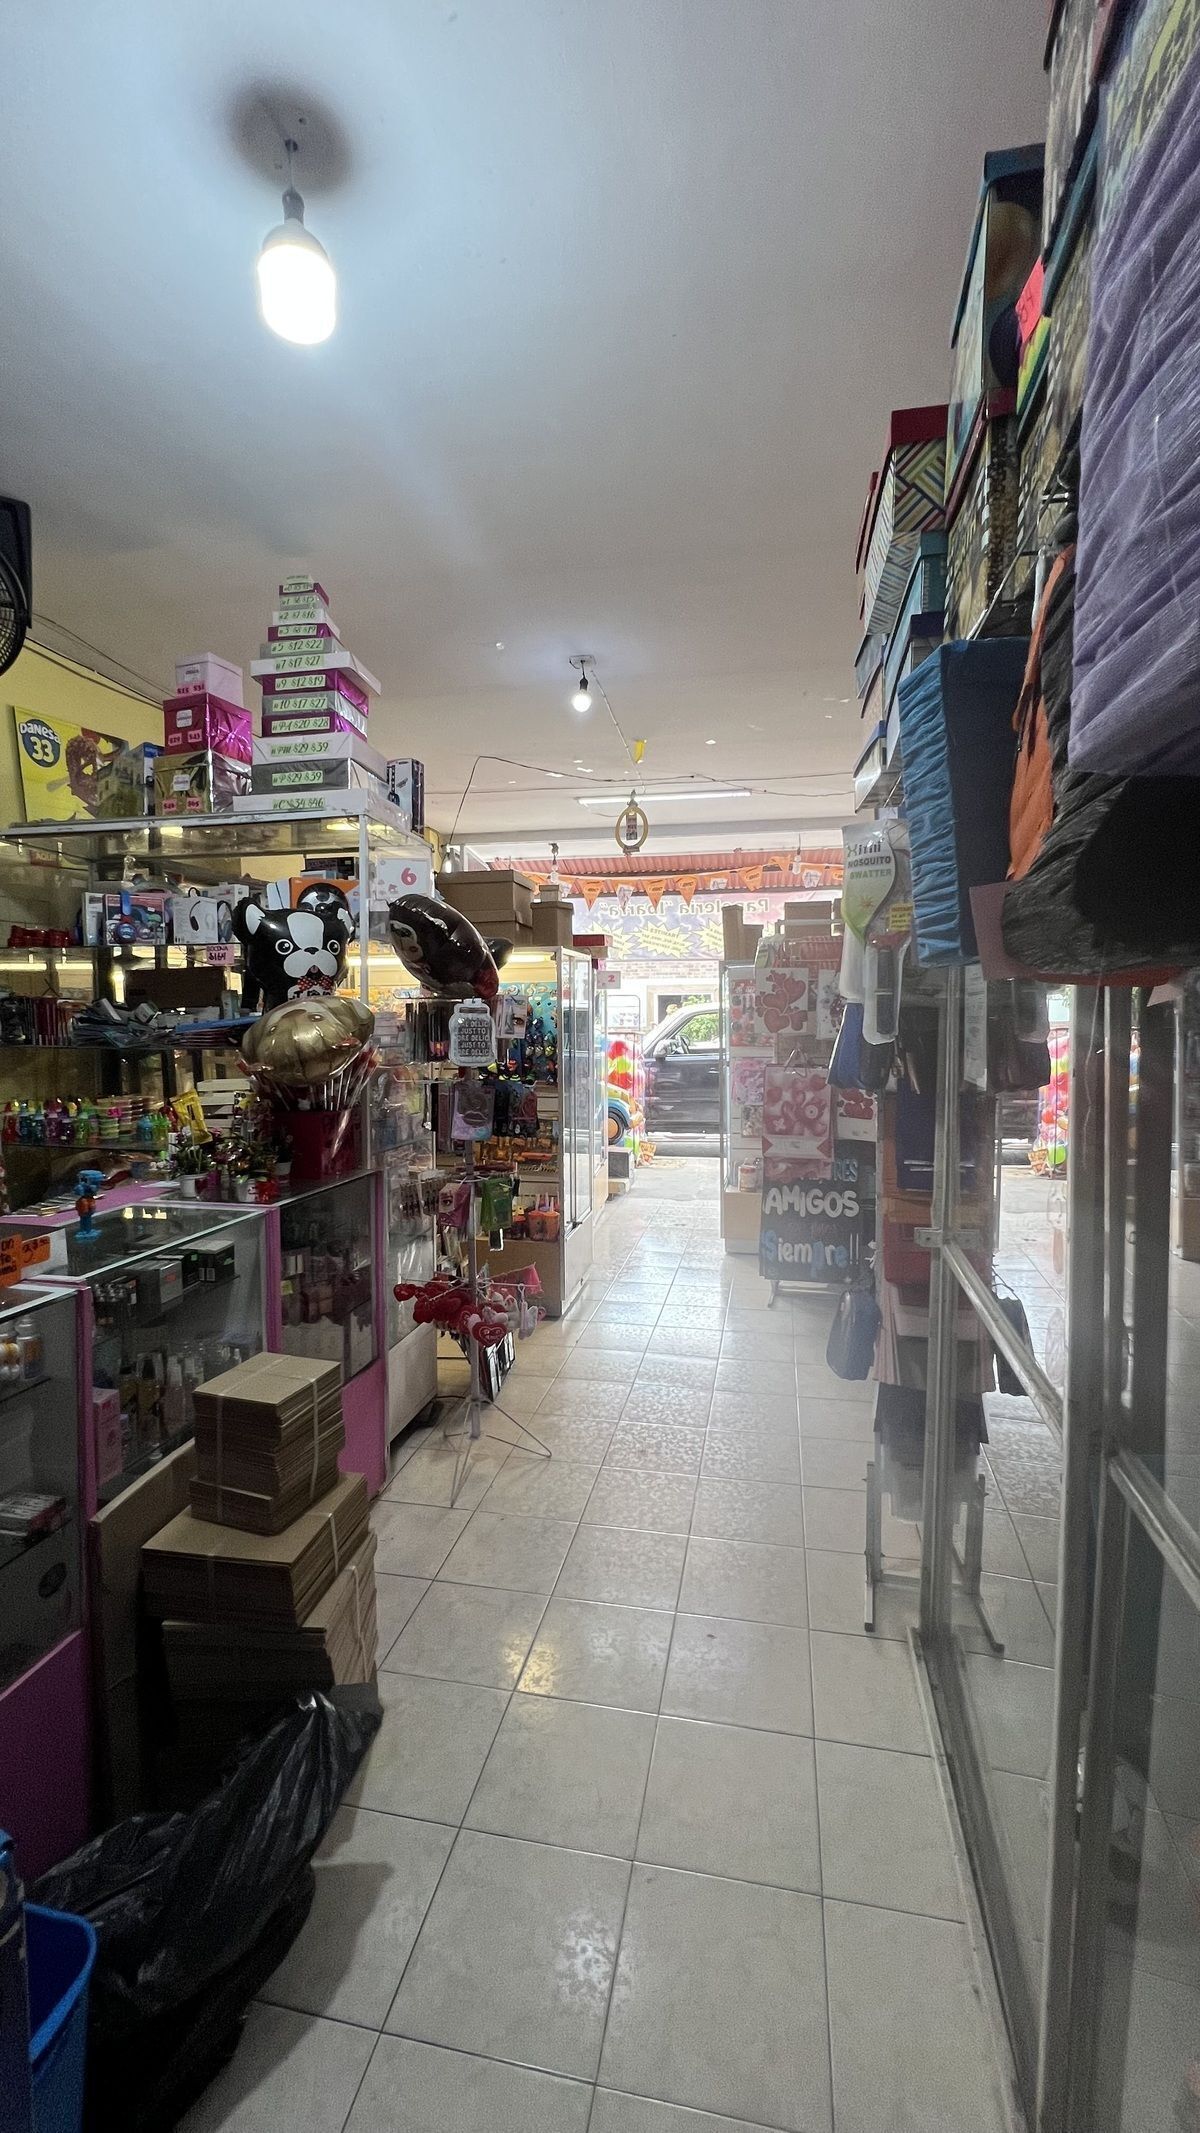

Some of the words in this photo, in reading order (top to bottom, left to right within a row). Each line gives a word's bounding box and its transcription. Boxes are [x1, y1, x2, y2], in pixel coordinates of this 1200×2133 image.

[30, 736, 54, 763] 33
[401, 868, 417, 886] 6
[763, 1185, 860, 1218] AMIGOS
